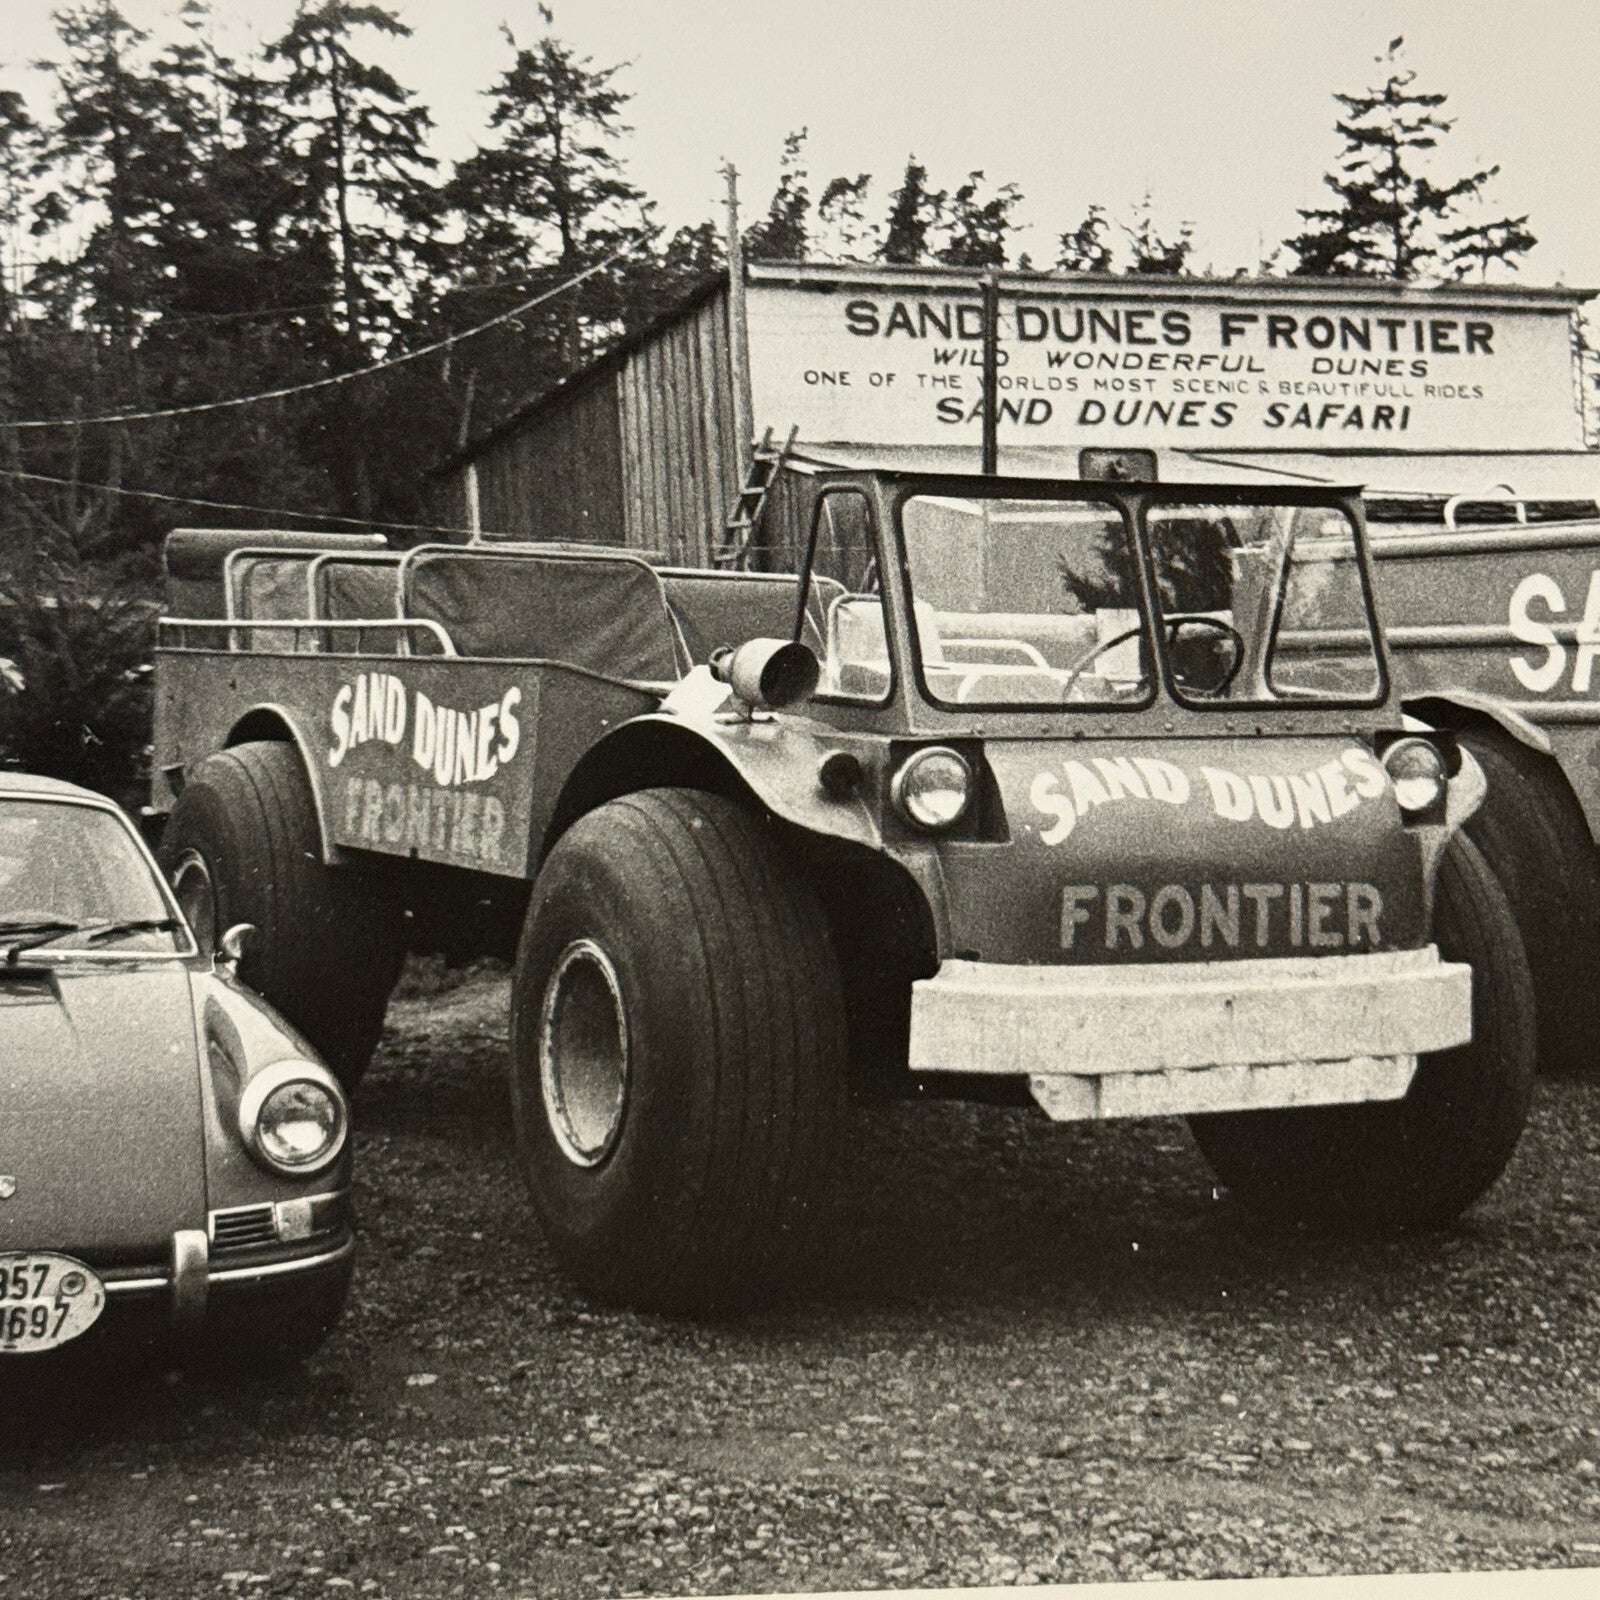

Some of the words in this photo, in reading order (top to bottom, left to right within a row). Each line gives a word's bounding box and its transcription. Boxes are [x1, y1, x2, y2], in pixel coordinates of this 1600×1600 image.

[845, 300, 988, 340] SAND
[1016, 305, 1191, 347] DUNES
[1220, 313, 1495, 355] FRONTIER
[804, 370, 850, 386] ONE
[869, 372, 896, 387] OF
[917, 373, 962, 389] THE
[1093, 378, 1157, 393] MOST
[1172, 378, 1249, 394] SCENIC
[1258, 381, 1270, 394] &
[1279, 381, 1414, 398] BEAUTIFULL
[1424, 384, 1484, 399] RIDES
[933, 346, 1010, 366] WILD
[1046, 350, 1265, 372] WONDERFUL
[1312, 357, 1429, 378] DUNES
[936, 397, 1053, 425] SAND
[1077, 399, 1238, 428] DUNES
[1263, 402, 1411, 430] SAFARI
[328, 672, 407, 768] SAND
[412, 686, 522, 787] DUNES
[346, 776, 505, 862] FRONTIER
[1030, 756, 1191, 846] SAND
[1201, 748, 1386, 829] DUNES
[1060, 882, 1384, 949] FRONTIER
